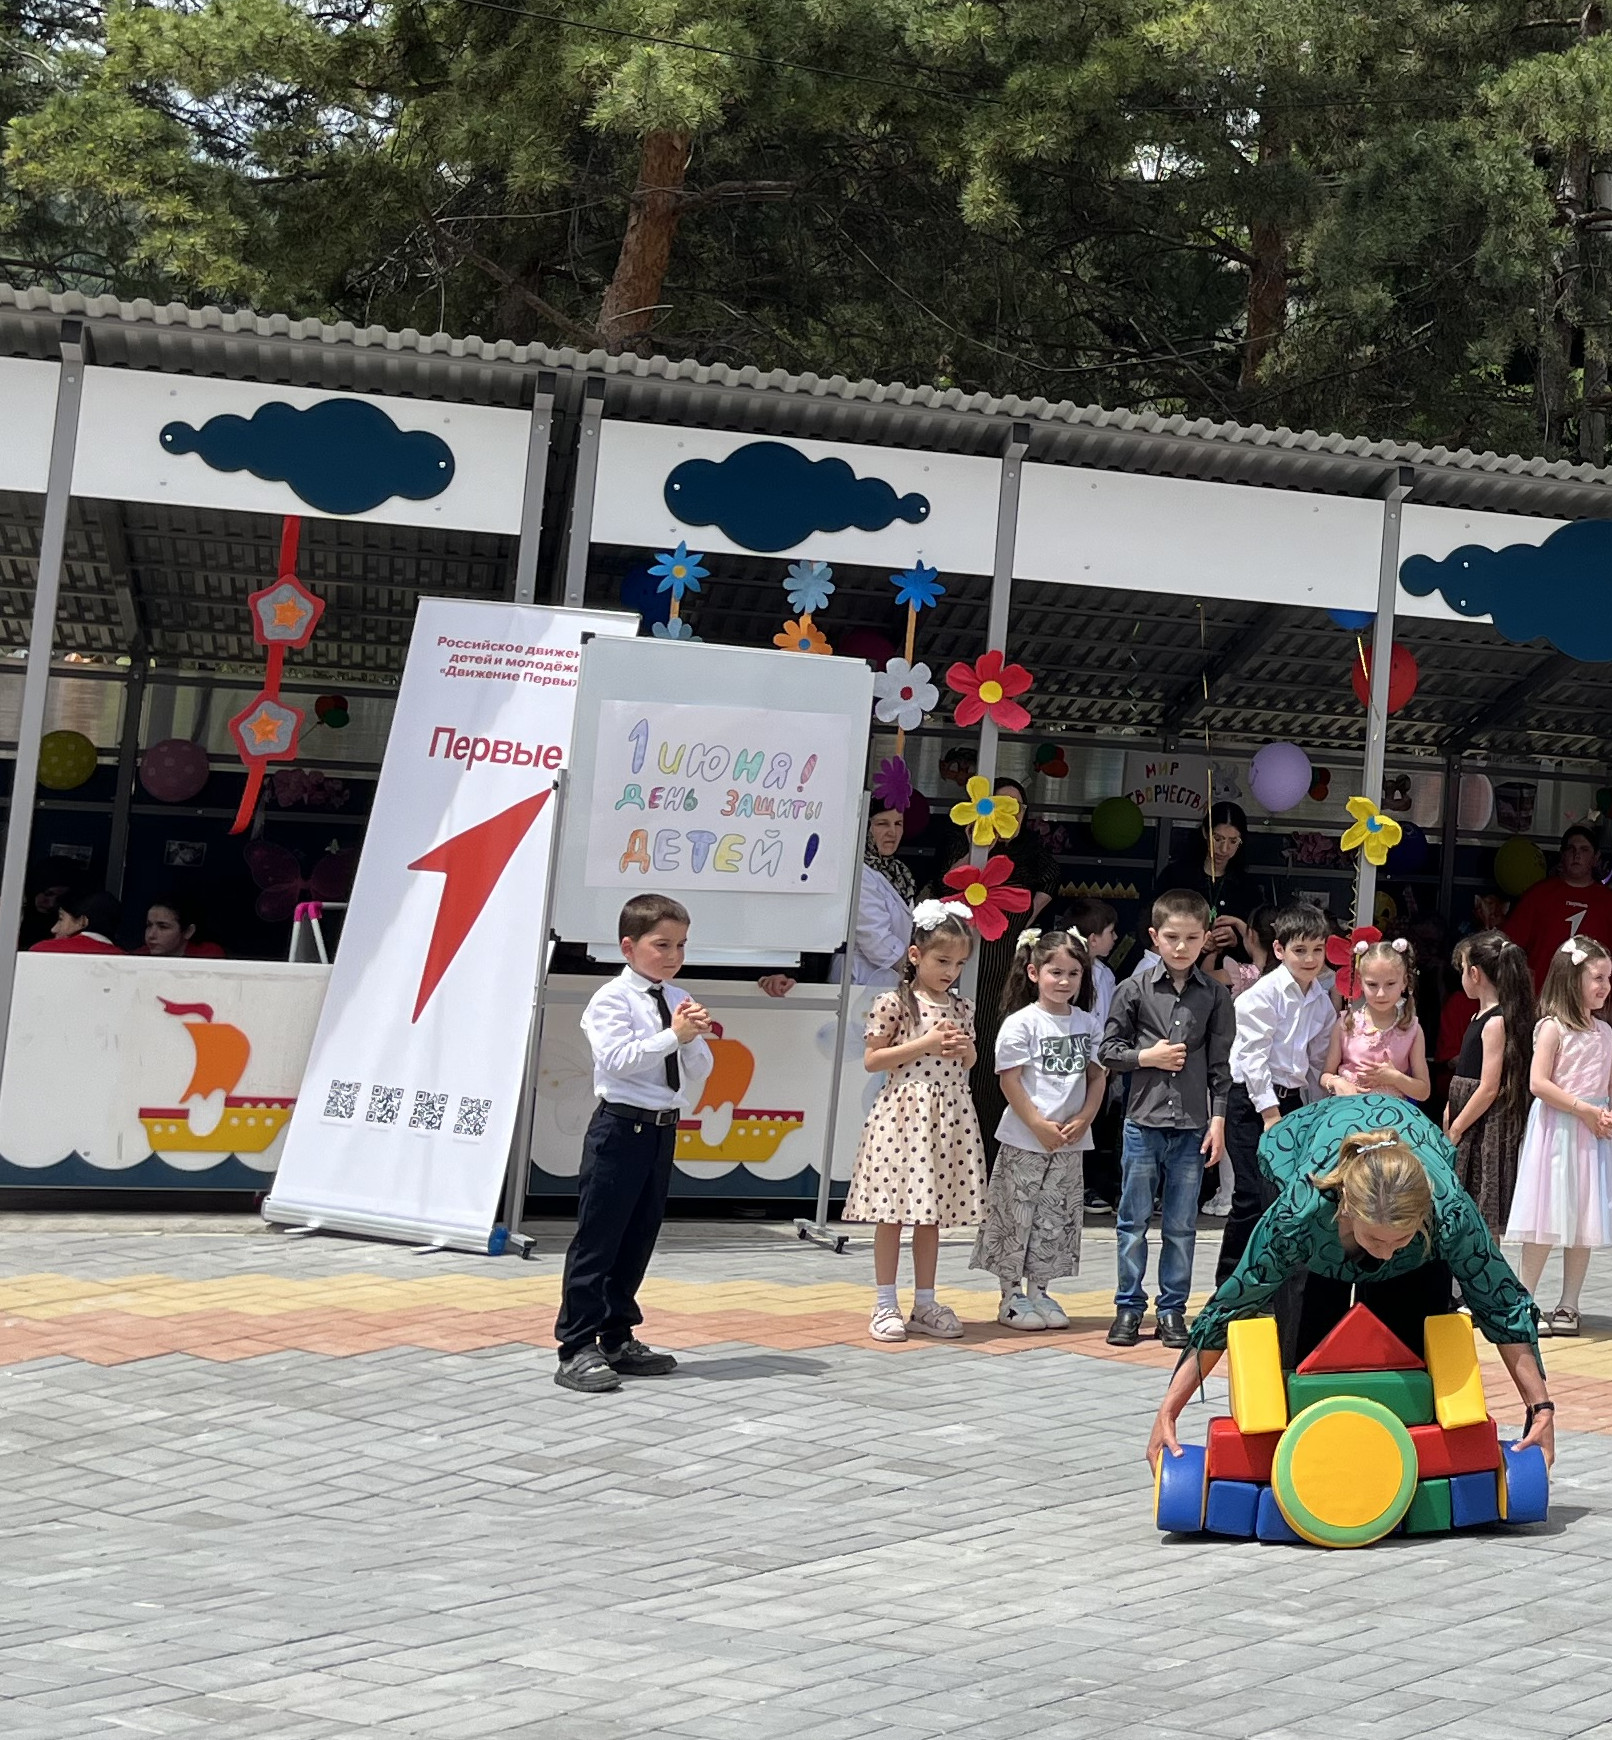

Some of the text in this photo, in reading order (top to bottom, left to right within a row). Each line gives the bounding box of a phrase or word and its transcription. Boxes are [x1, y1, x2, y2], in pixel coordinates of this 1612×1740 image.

[437, 636, 580, 658] Российское движен
[449, 653, 492, 665] детей
[494, 657, 503, 665] и
[440, 665, 578, 687] «Движение Первы
[428, 726, 563, 771] Первые
[629, 718, 649, 774] 1
[1145, 761, 1179, 779] МИР
[615, 784, 823, 820] ДЕНЬ ЗАЩИТЫ
